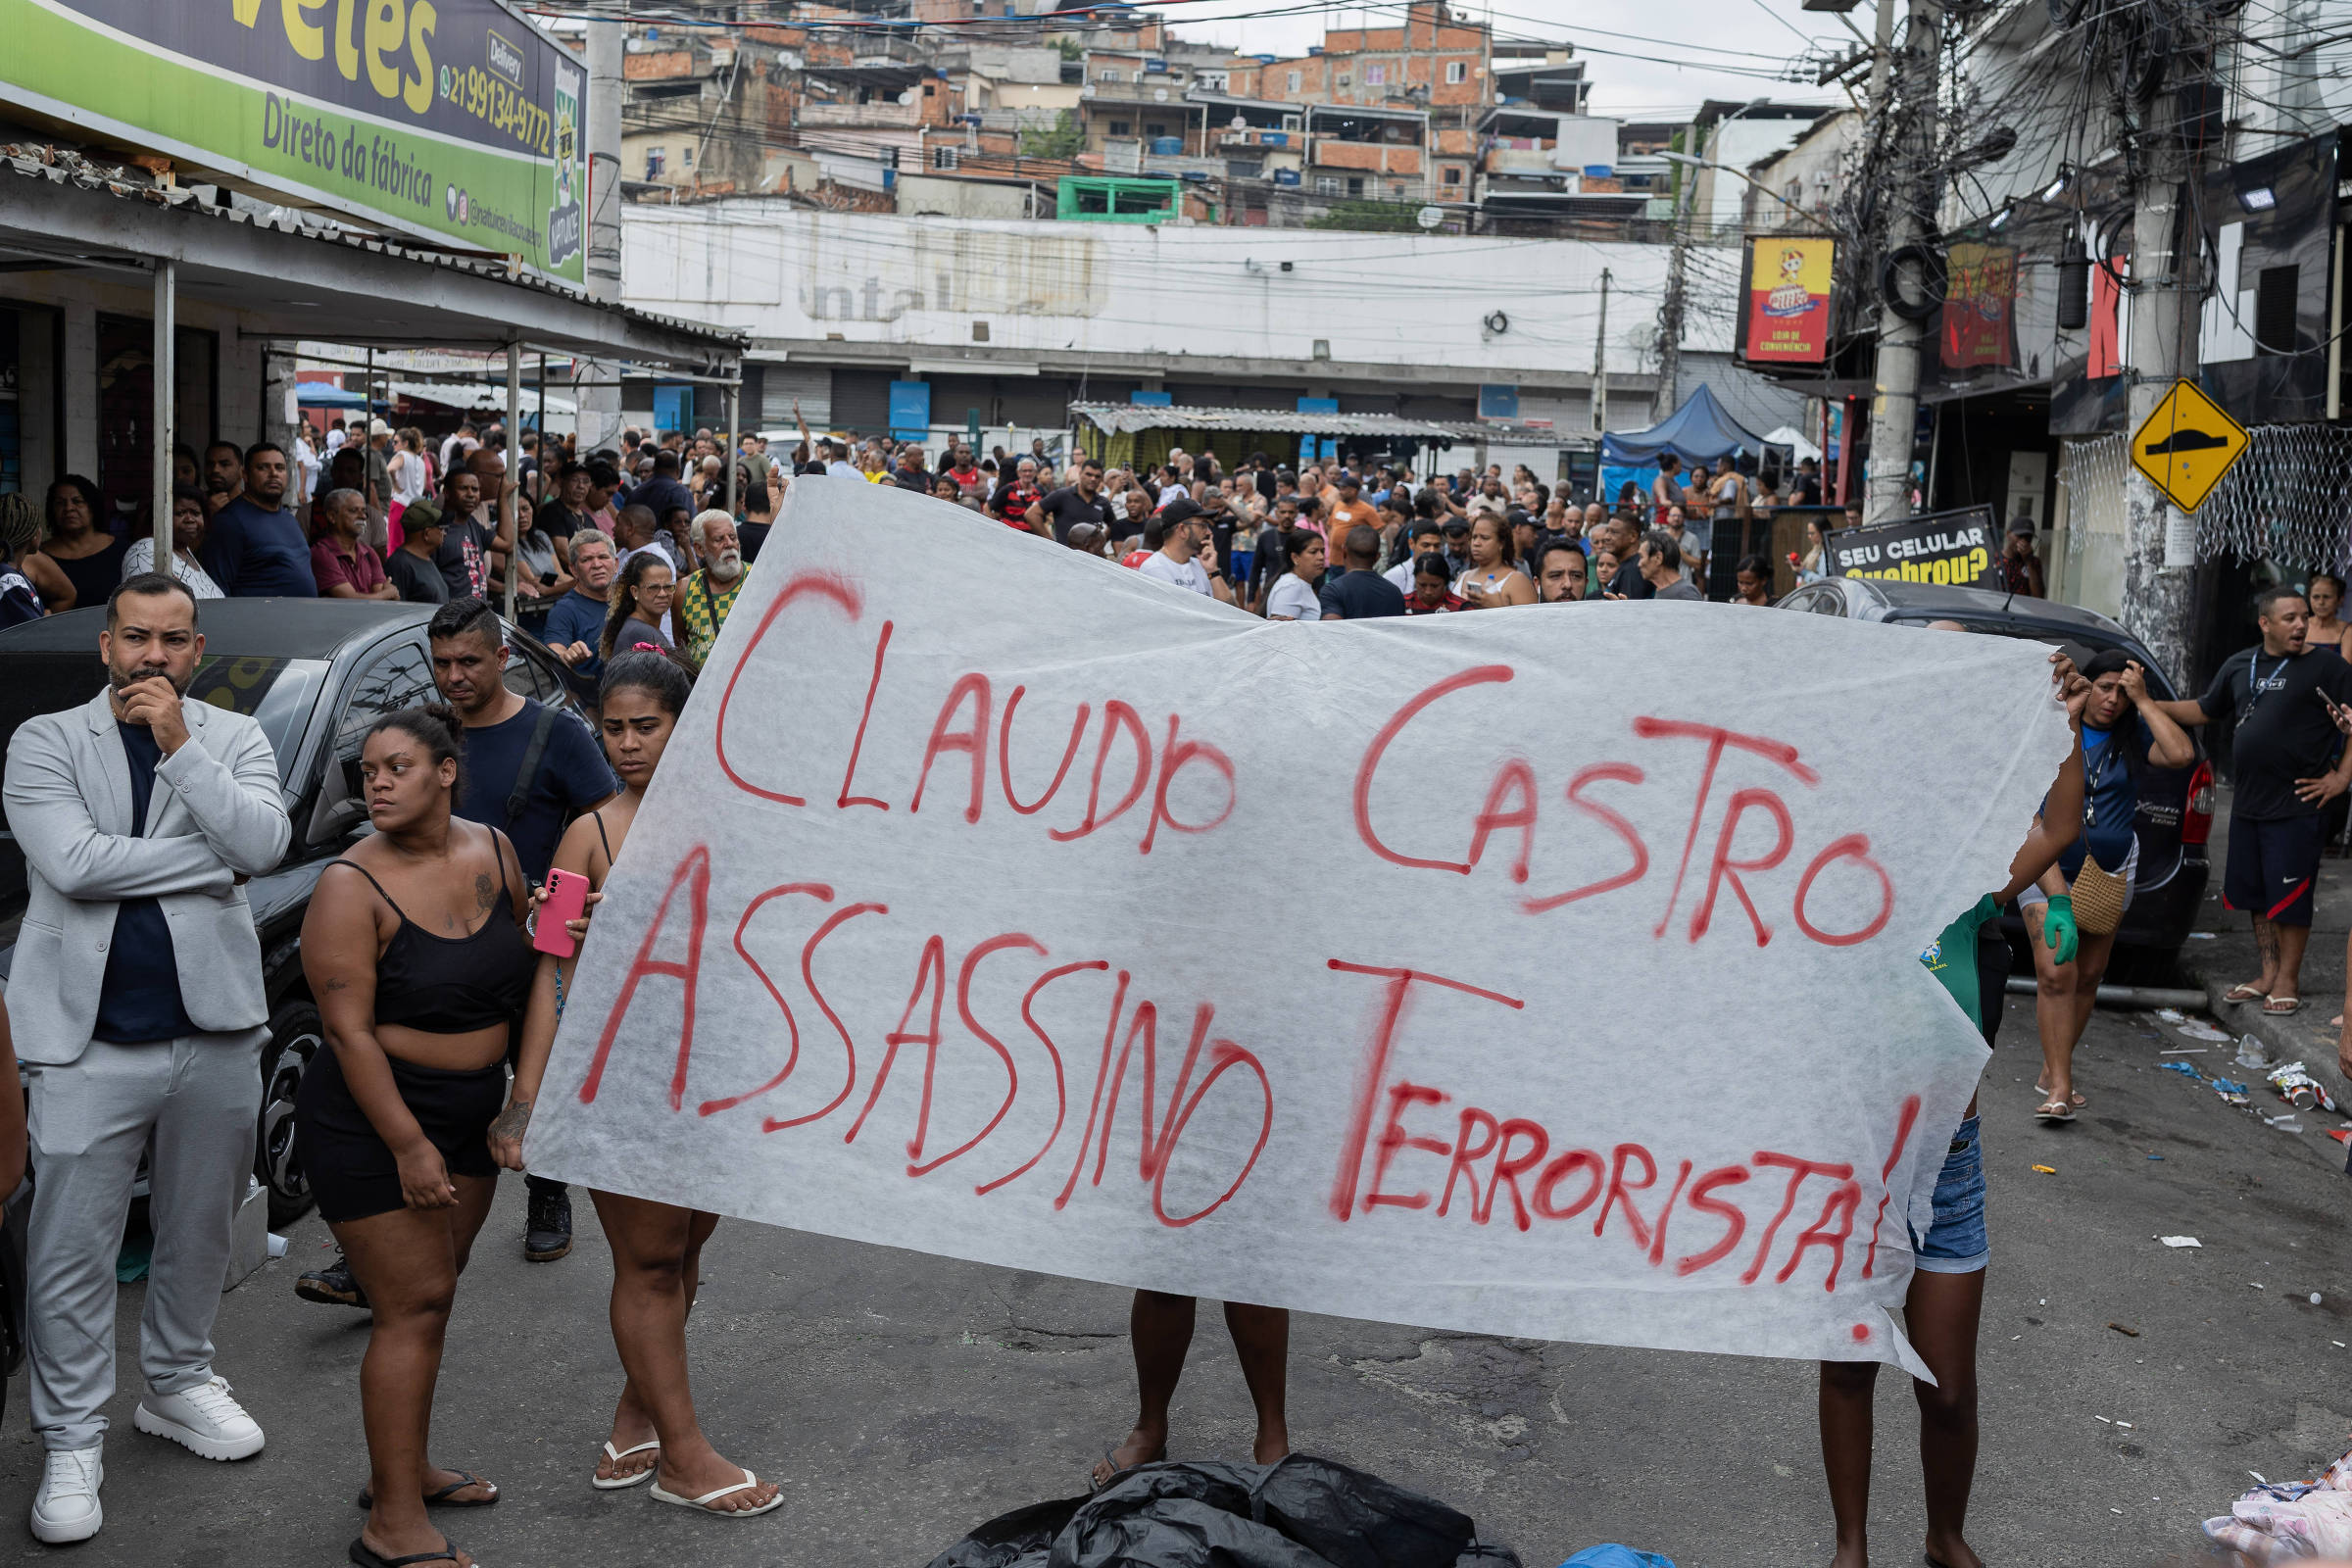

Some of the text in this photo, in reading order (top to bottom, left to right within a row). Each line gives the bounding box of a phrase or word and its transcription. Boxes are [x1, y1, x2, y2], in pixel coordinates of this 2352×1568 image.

[466, 65, 552, 156] 99134-9772
[490, 37, 521, 82] Delivery
[263, 91, 432, 208] Direto da fábrica
[1838, 527, 1985, 567] SEU CELULAR
[1353, 664, 1893, 947] CASTRO
[580, 844, 1920, 1342] ASSASSINO TERRORISTA!
